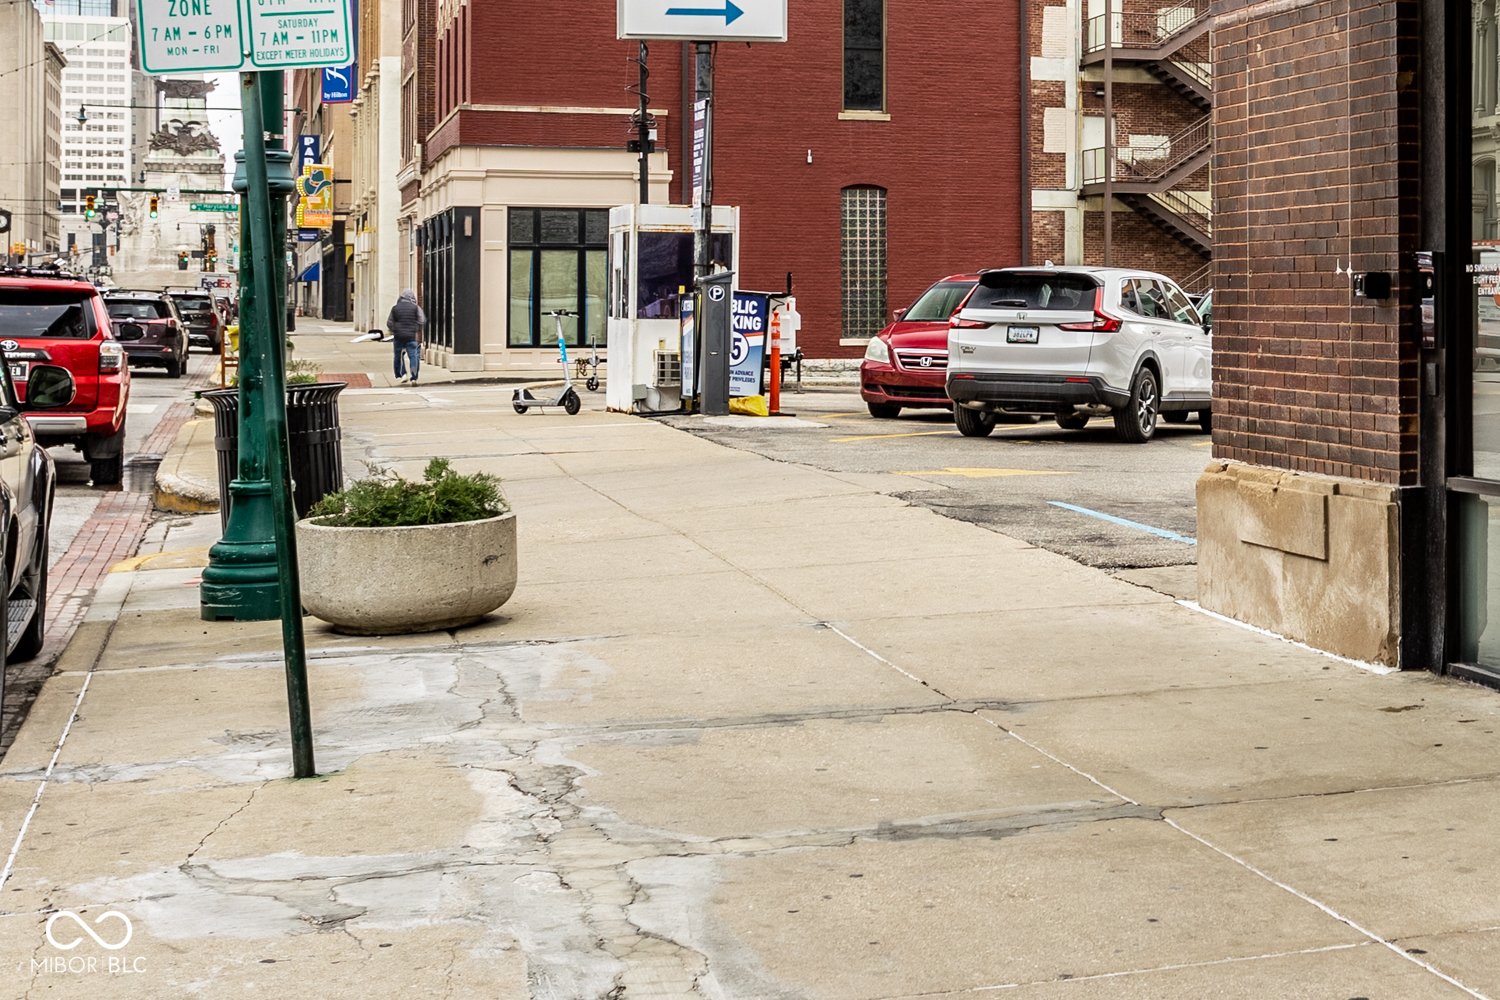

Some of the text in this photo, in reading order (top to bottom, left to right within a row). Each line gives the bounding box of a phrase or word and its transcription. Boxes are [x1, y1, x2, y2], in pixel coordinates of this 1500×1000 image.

[278, 18, 319, 29] SATURDAY
[152, 28, 158, 42] 7
[164, 26, 181, 42] AM
[204, 26, 211, 40] 6
[216, 24, 232, 38] PM
[260, 32, 266, 46] 7
[272, 32, 289, 46] AM
[167, 46, 188, 56] MON
[204, 45, 220, 54] FRI
[256, 47, 344, 62] EXCEPT METER HOLIDAYS
[201, 278, 232, 288] FedEx
[713, 288, 722, 298] P
[732, 300, 758, 314] BLIC
[732, 314, 762, 330] KING
